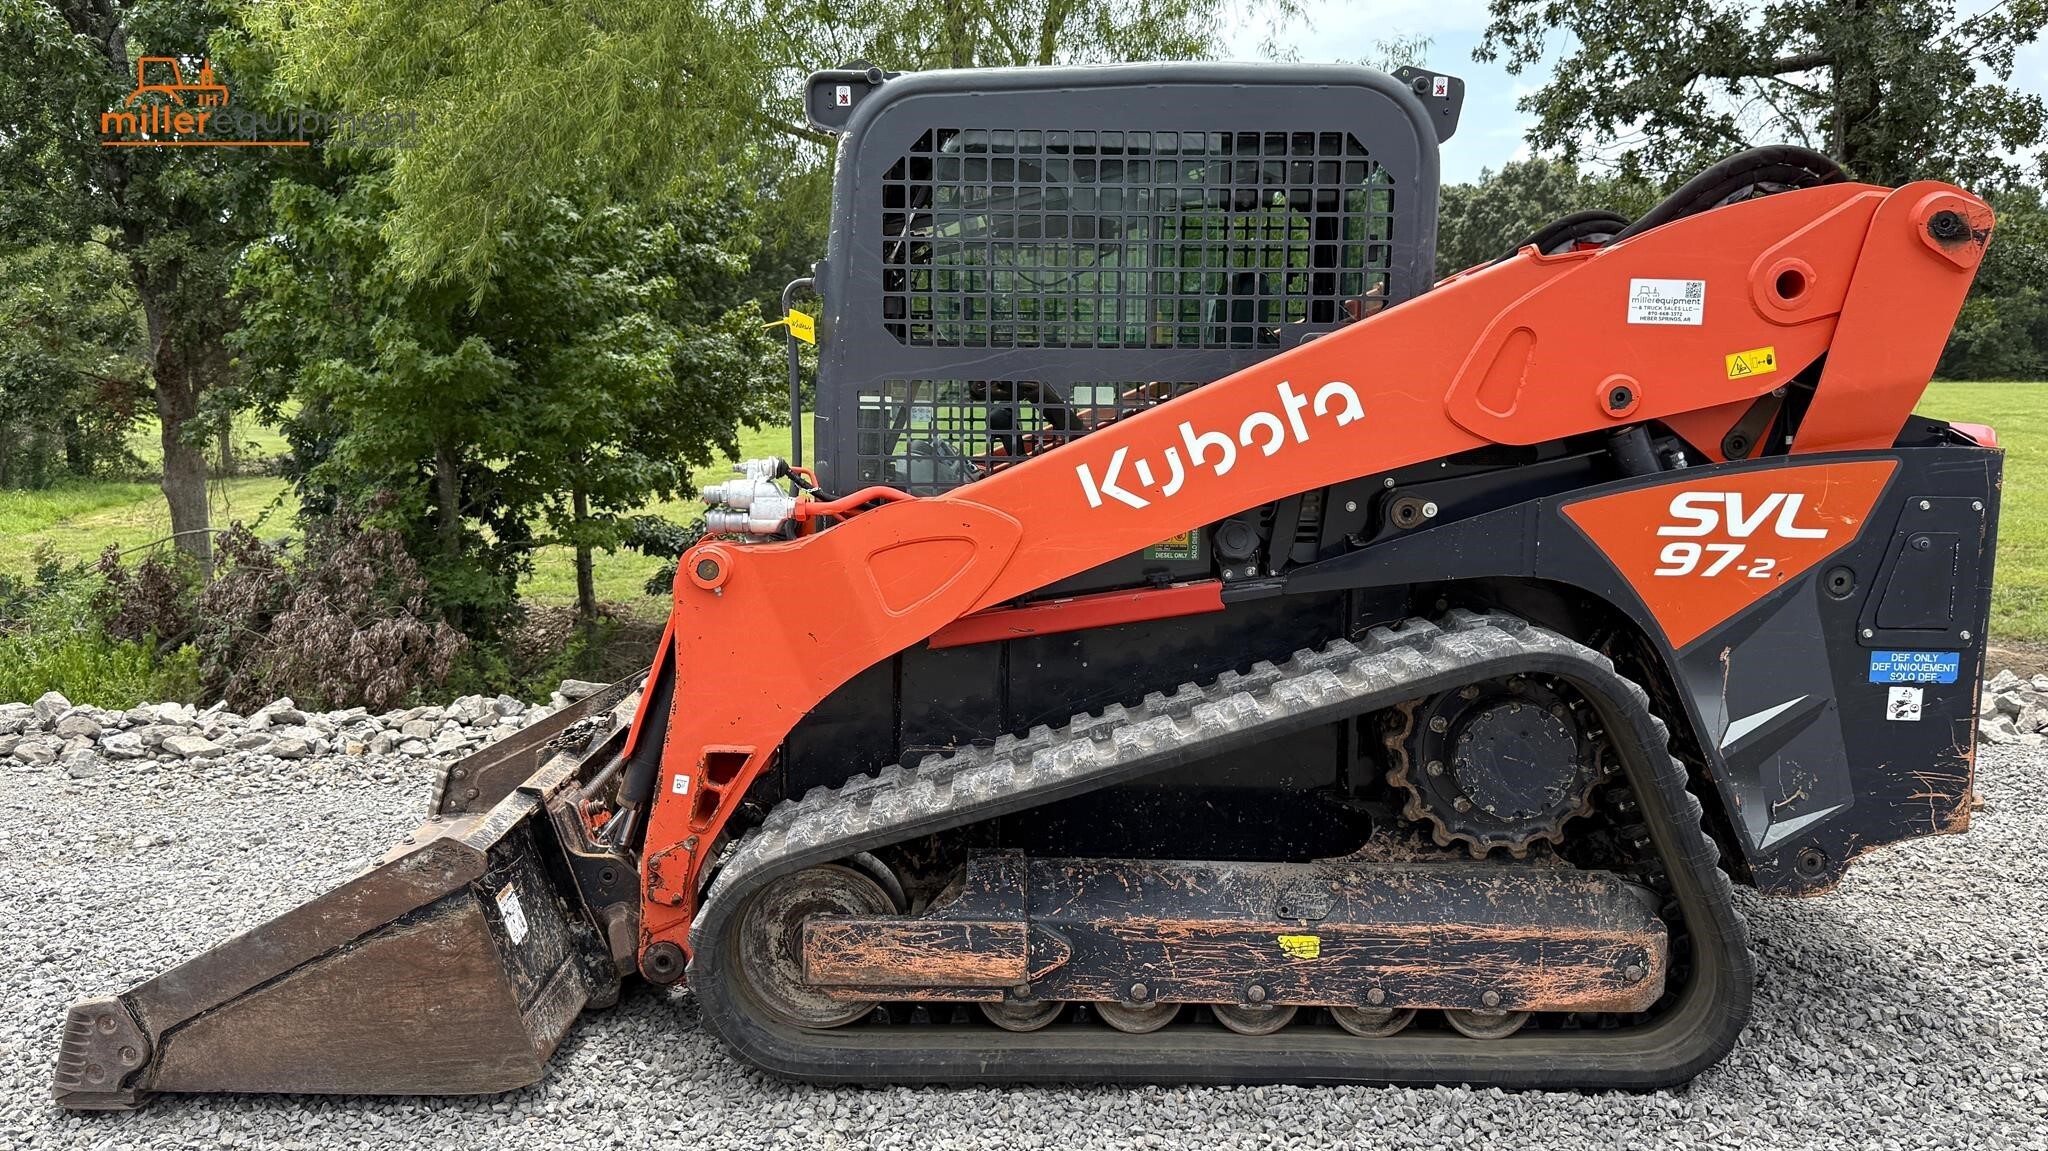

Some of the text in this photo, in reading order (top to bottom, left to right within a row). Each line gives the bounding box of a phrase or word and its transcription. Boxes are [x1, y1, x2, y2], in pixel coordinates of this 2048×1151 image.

[1631, 296, 1701, 306] millerequipment
[1075, 380, 1366, 510] Kubota
[1656, 491, 1829, 539] SVL
[1653, 542, 1776, 578] 97-2
[1891, 653, 1939, 662] DEF ONLY
[1872, 662, 1957, 672] DEF UNIQUEMENT
[1889, 672, 1915, 681] SOLO
